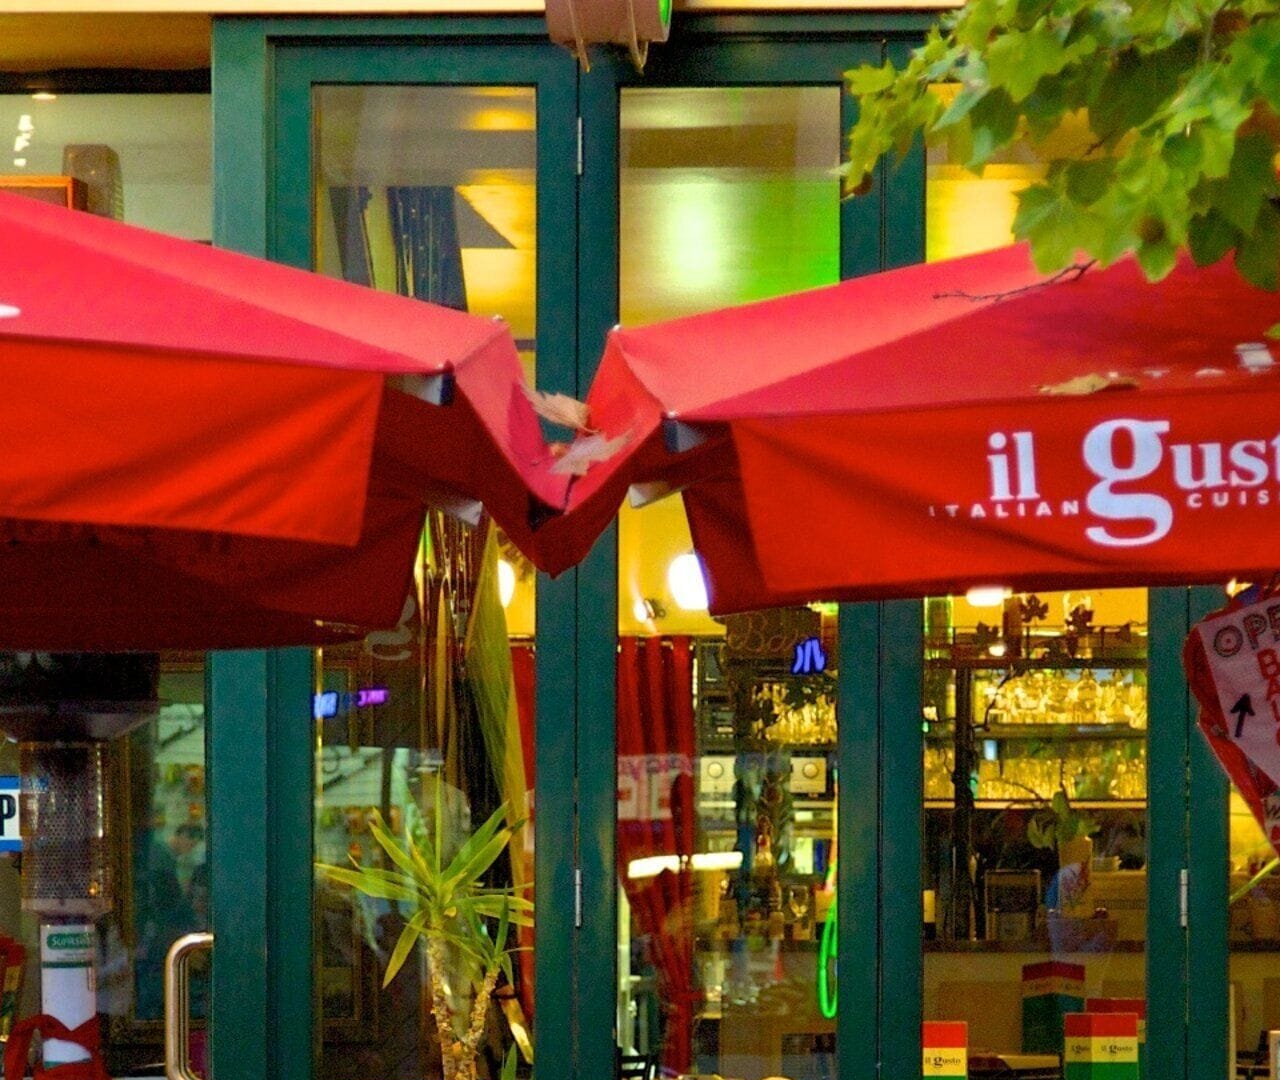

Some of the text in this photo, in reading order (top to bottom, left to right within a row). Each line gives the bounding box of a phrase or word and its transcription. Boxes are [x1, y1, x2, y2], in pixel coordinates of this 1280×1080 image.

[988, 431, 1040, 501] il
[929, 500, 1079, 518] ITALIAN
[1109, 1044, 1133, 1055] gusto
[933, 1056, 961, 1068] gusto
